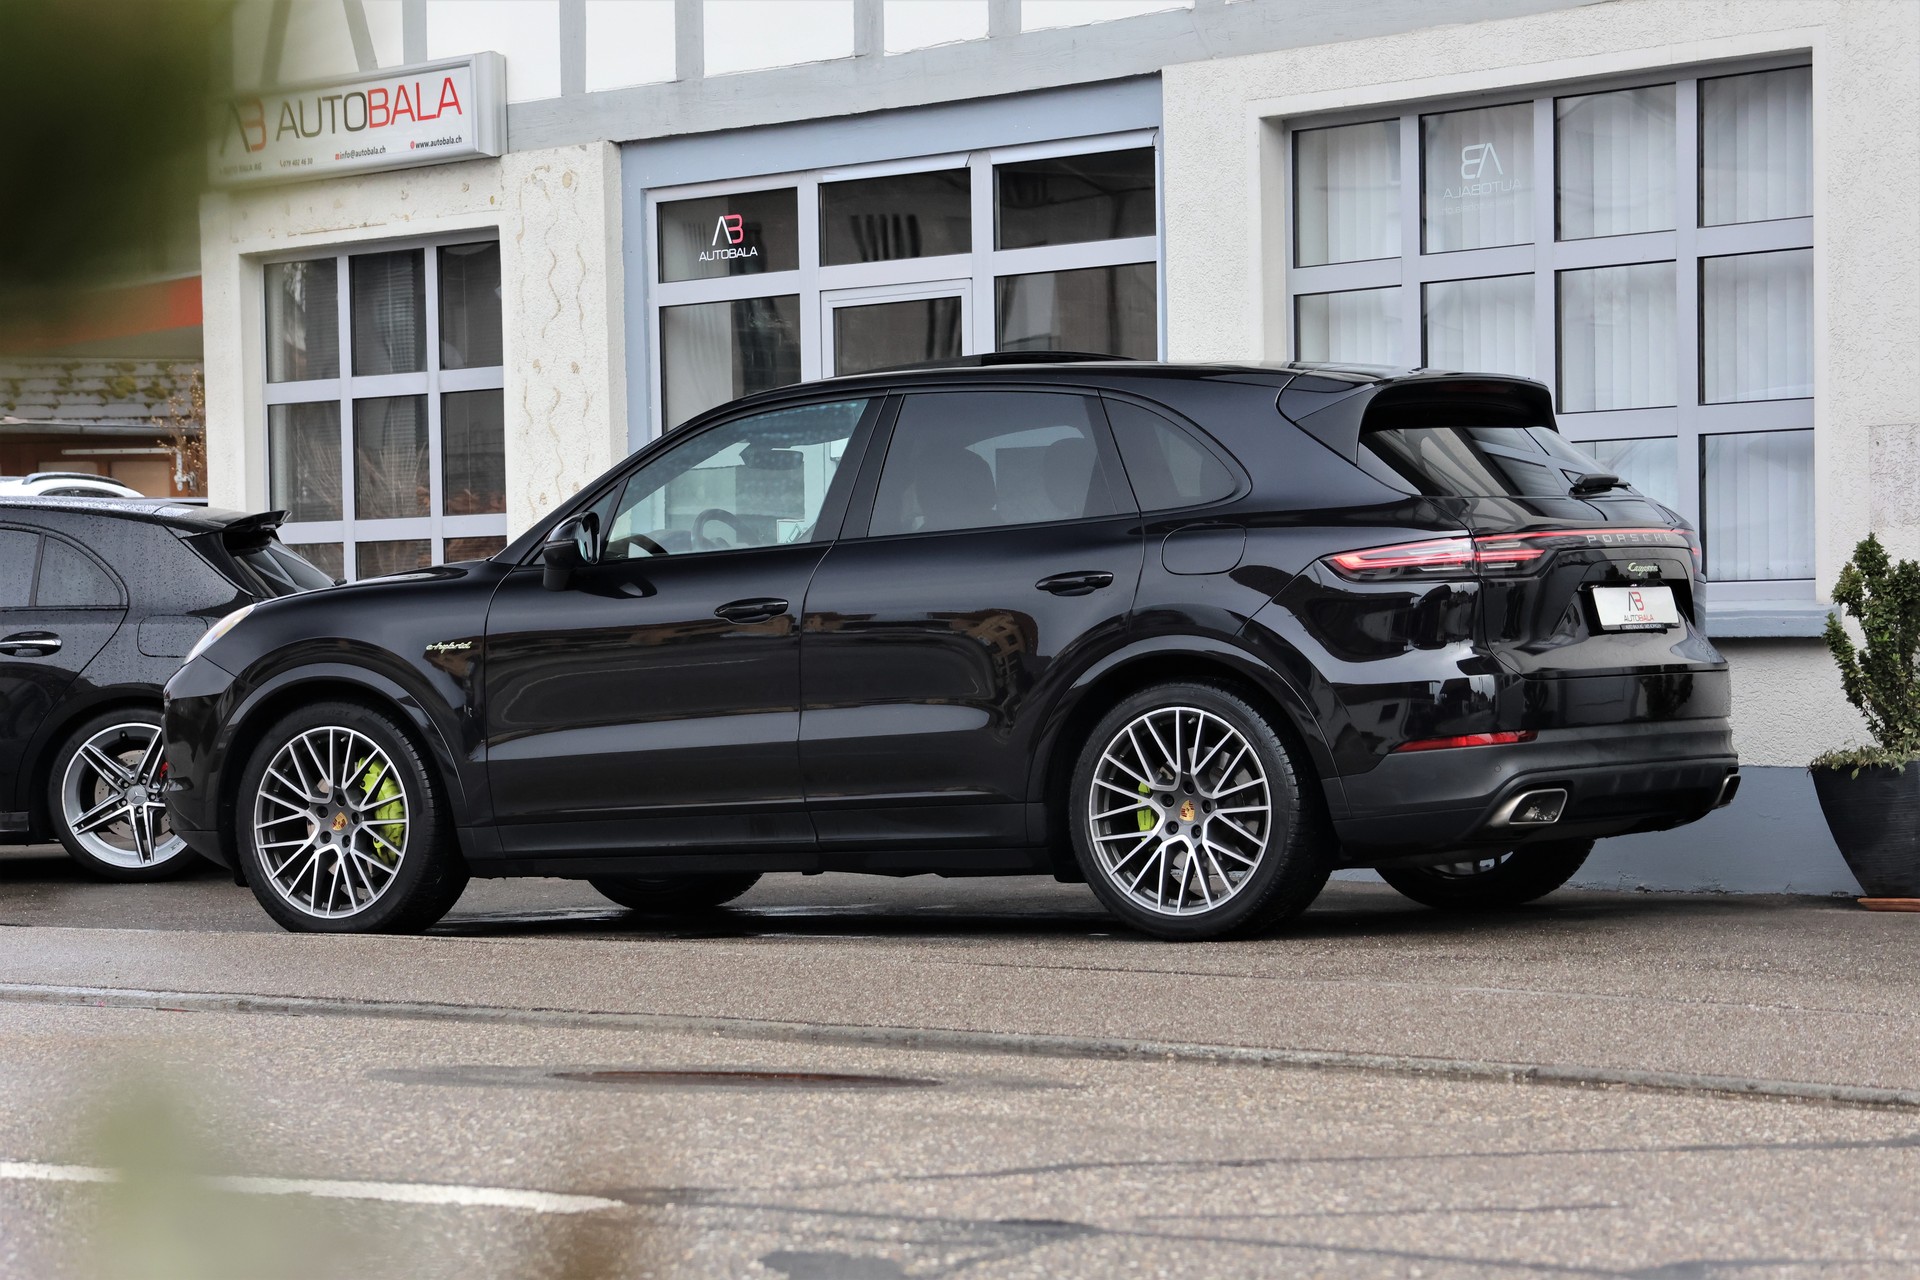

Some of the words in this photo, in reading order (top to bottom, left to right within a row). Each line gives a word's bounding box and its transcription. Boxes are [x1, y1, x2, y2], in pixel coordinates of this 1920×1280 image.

[275, 76, 463, 142] AUTOBALA
[415, 135, 463, 149] www.autobala.ch
[339, 145, 387, 160] info@autobala.ch
[699, 246, 758, 262] AUTOBALA
[1586, 533, 1672, 544] PORSCHE
[1624, 614, 1655, 622] AUTOBALA
